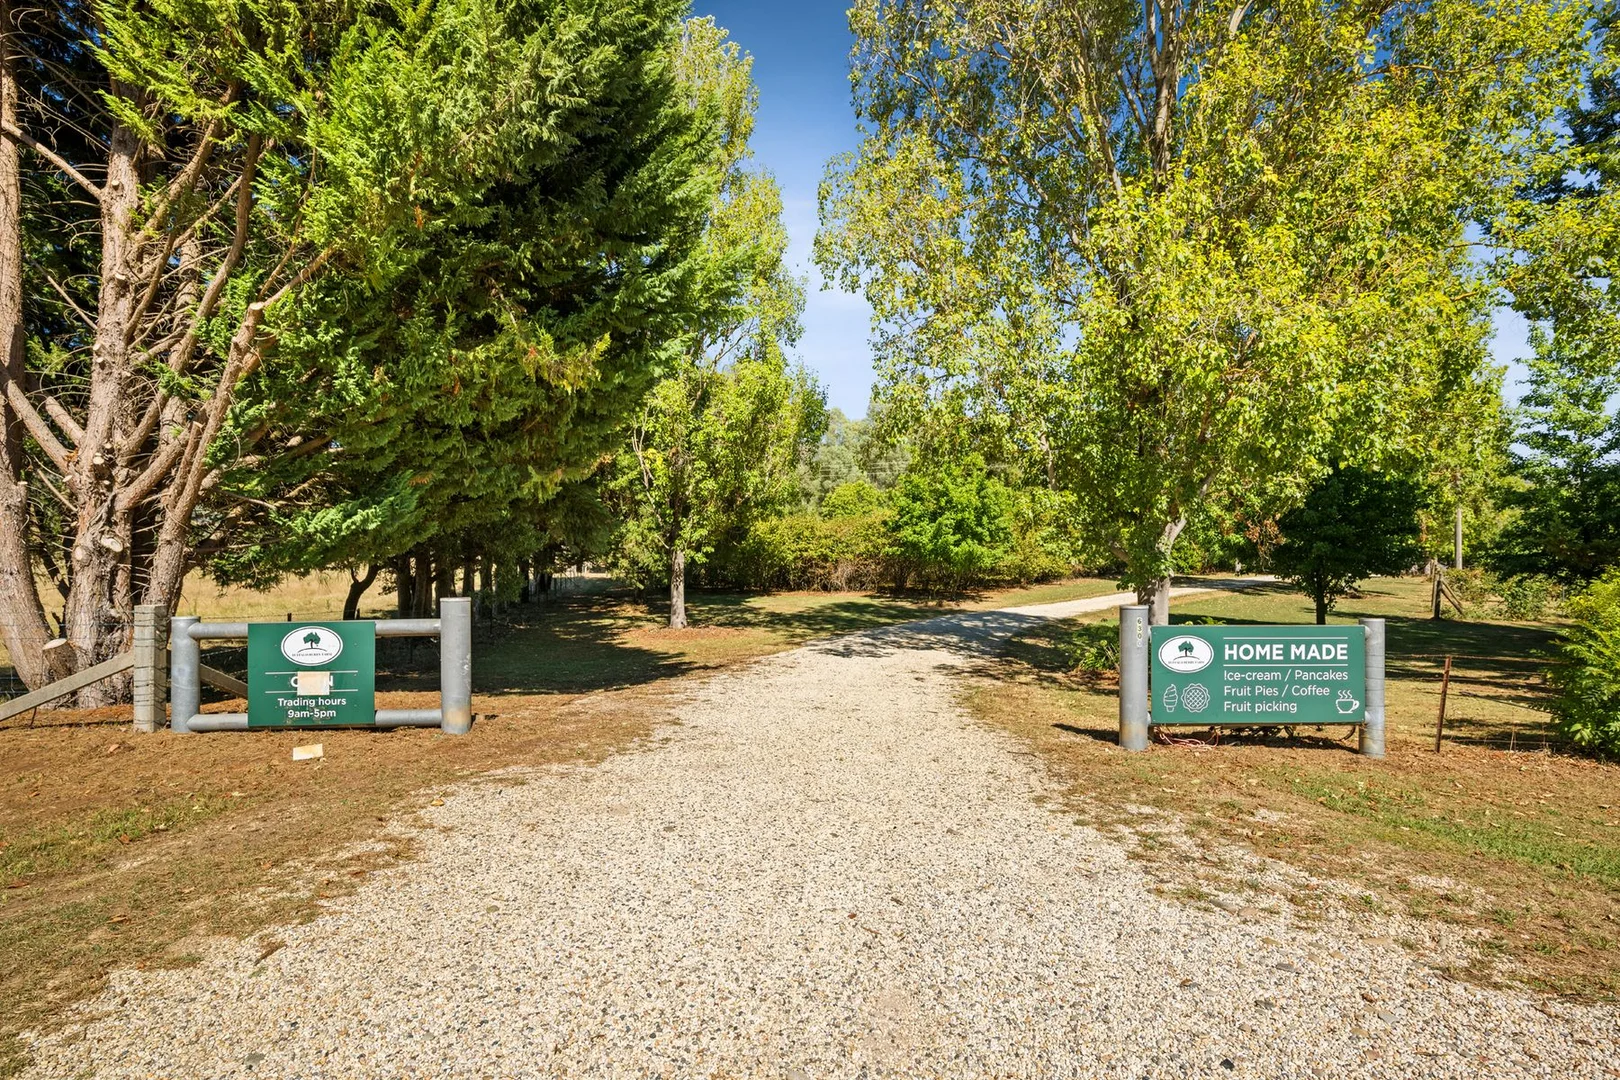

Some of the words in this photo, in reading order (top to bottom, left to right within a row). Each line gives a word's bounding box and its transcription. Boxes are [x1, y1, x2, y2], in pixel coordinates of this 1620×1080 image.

[1224, 644, 1284, 660] HOME
[1290, 643, 1348, 660] MADE
[1223, 670, 1282, 681] Ice-cream
[1284, 669, 1292, 682] /
[1294, 669, 1348, 681] Pancakes
[1223, 685, 1252, 697] Fruit
[1255, 685, 1279, 697] Pies
[1281, 684, 1289, 698] /
[1291, 684, 1330, 696] Coffee
[277, 697, 316, 707] Trading
[318, 697, 347, 706] hours
[1223, 701, 1252, 712] Fruit
[1255, 701, 1297, 714] picking
[287, 709, 337, 719] 9am-5pm
